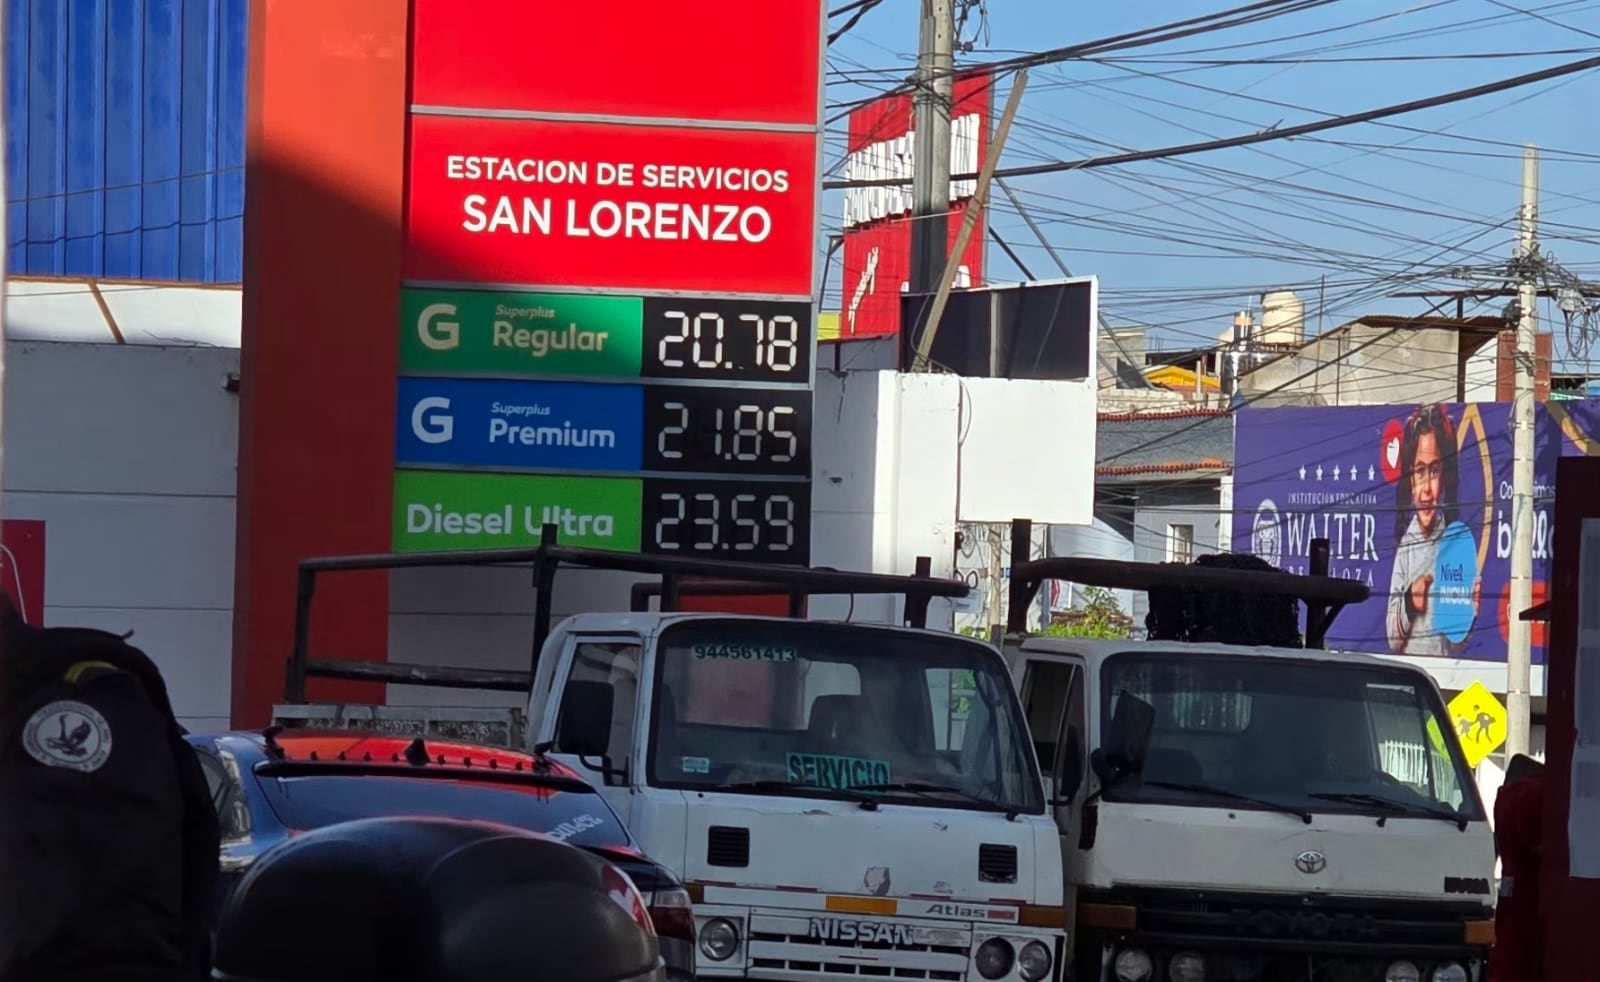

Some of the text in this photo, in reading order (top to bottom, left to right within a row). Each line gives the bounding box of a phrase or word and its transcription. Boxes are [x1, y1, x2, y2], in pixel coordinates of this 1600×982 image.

[447, 155, 789, 193] ESTACION DE SERVICIOS
[463, 194, 772, 243] SAN LORENZO
[417, 303, 460, 351] G
[495, 304, 555, 321] Superplus
[493, 321, 609, 357] Regular
[658, 310, 799, 373] 20.78
[411, 396, 454, 445] G
[491, 402, 551, 417] Superplus
[489, 418, 616, 449] Premium
[658, 402, 798, 463] 21.85
[407, 503, 614, 537] Diesel Ultra
[655, 493, 796, 552] 23.59
[1286, 512, 1379, 561] WALTER
[1440, 563, 1464, 582] Nivel
[694, 644, 796, 663] 944561413
[788, 754, 889, 790] SERVICIO
[926, 903, 986, 918] Atlas
[809, 918, 913, 945] NISSAN
